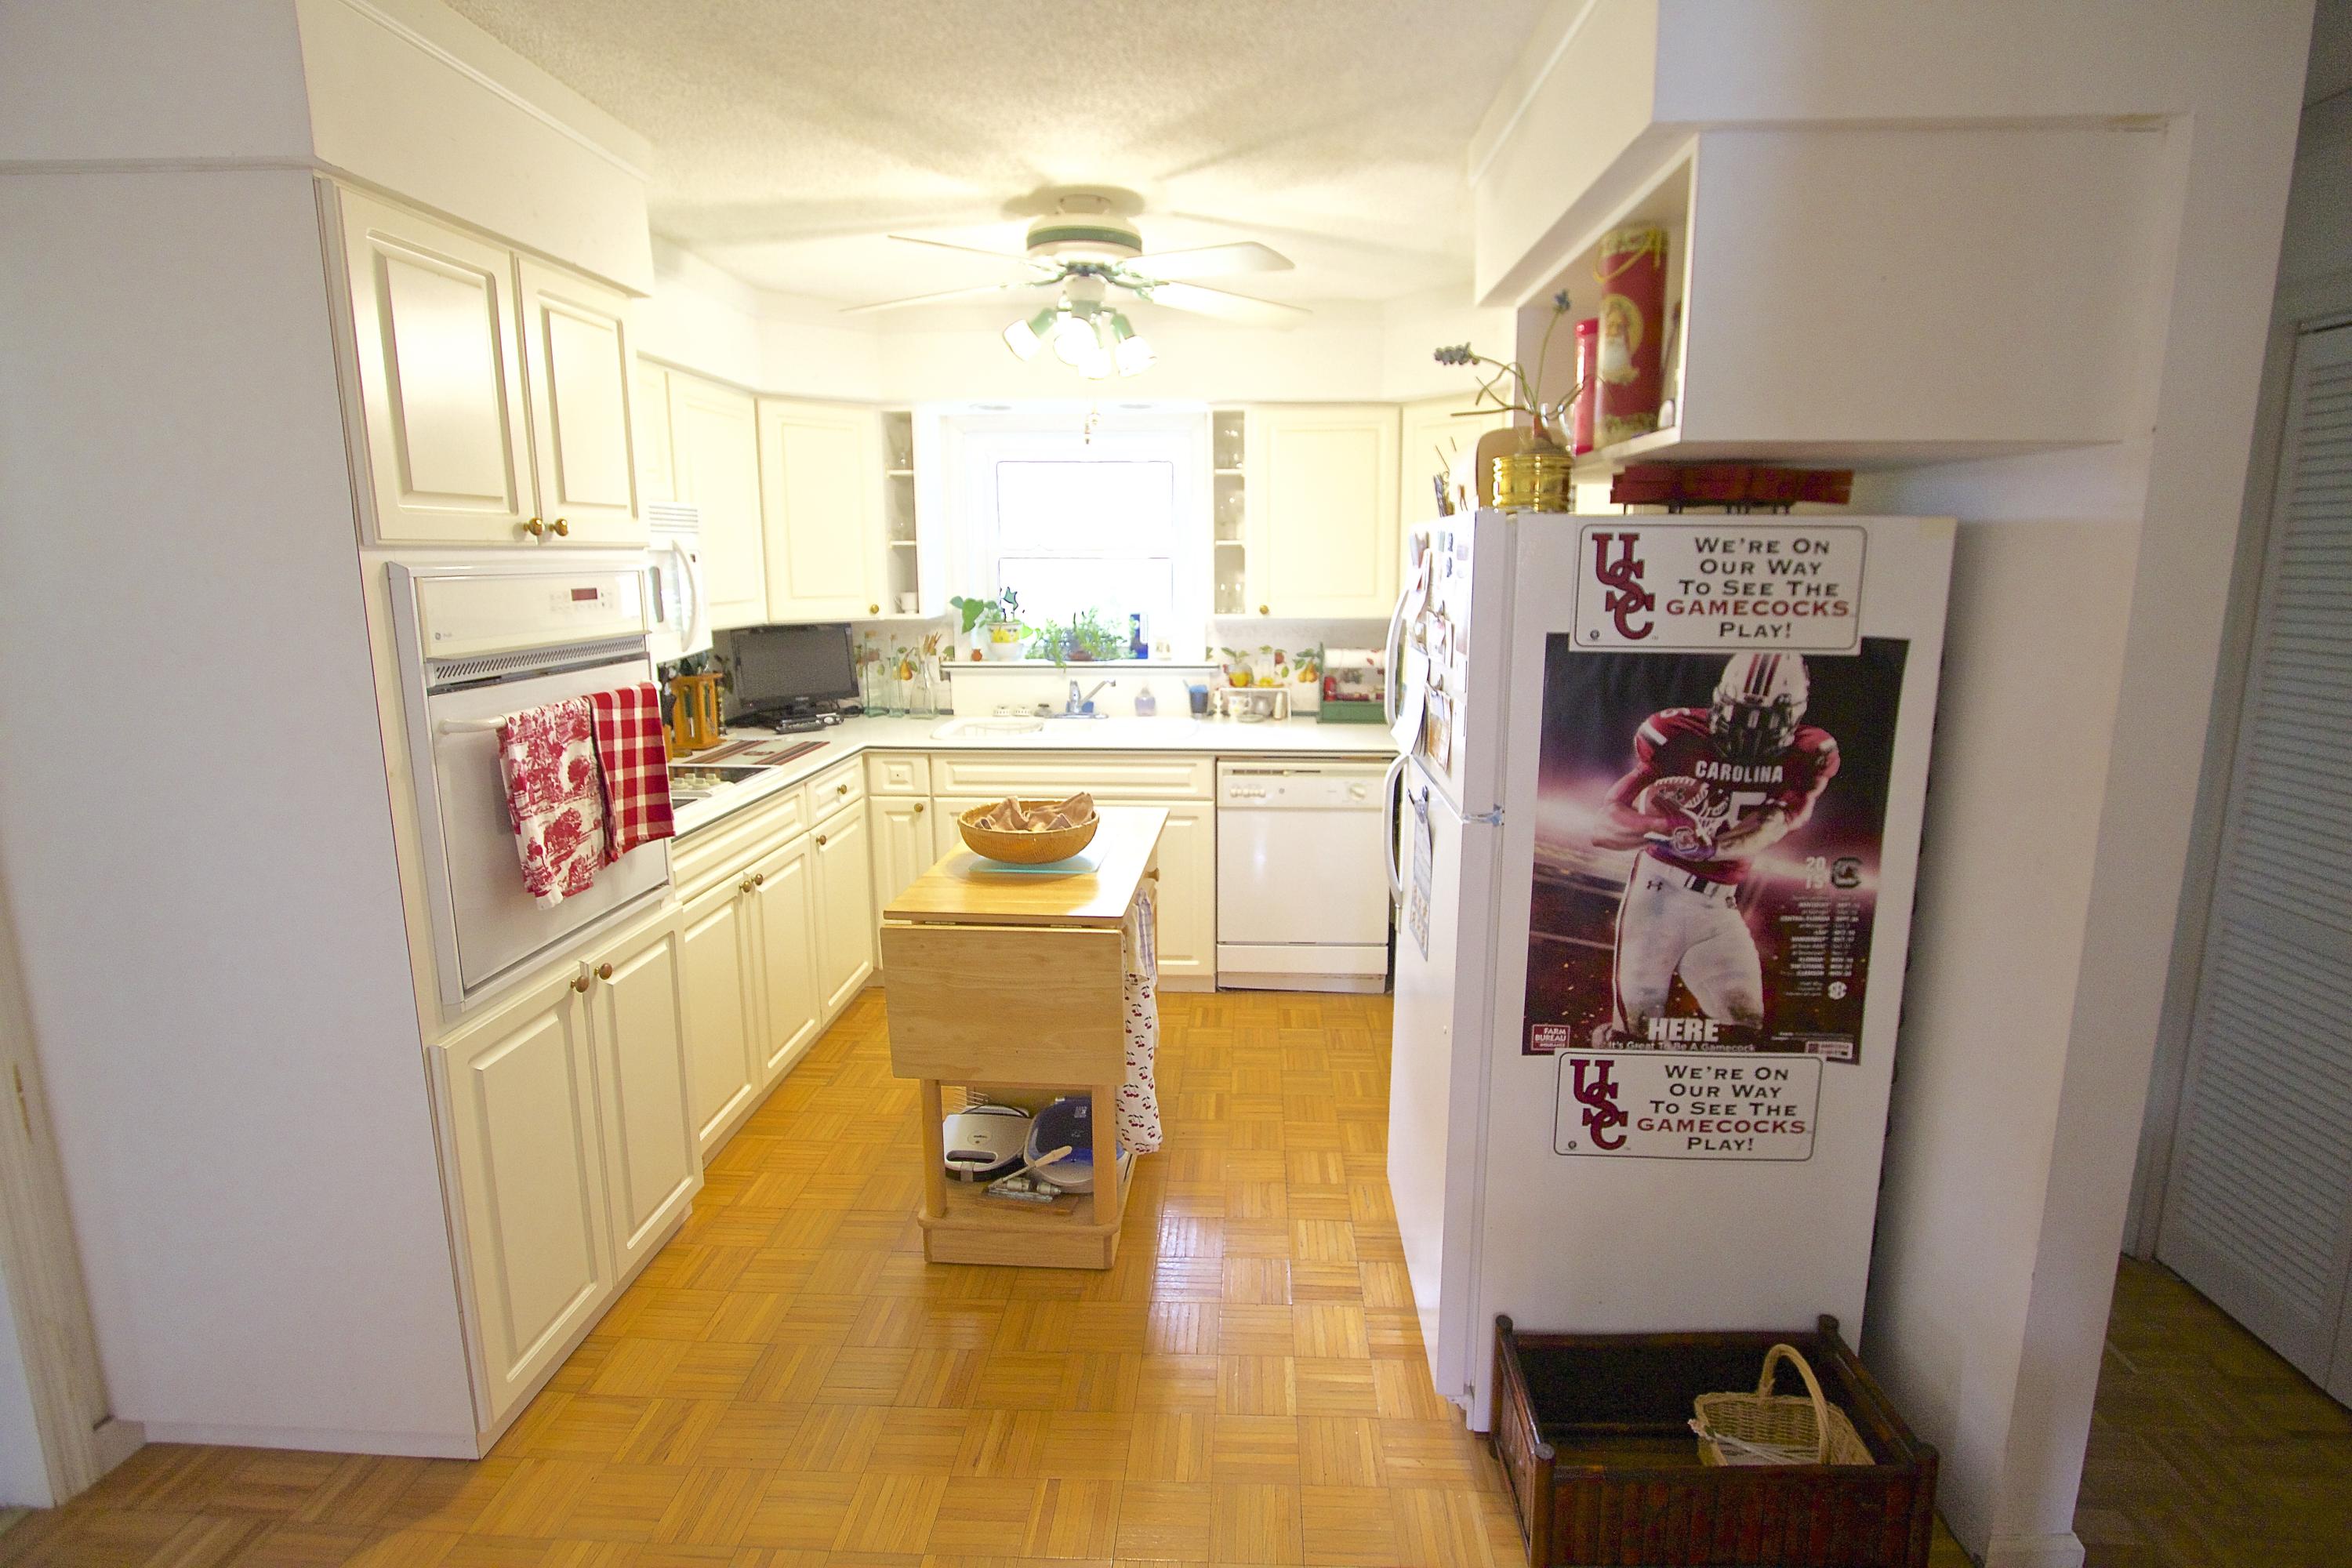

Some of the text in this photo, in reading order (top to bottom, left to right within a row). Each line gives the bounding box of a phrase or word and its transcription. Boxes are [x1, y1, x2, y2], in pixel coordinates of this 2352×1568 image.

[1695, 536, 1830, 554] WE'RE ON
[1700, 559, 1822, 575] OUR WAY
[1679, 579, 1838, 597] TO SEE THE
[1666, 600, 1849, 616] GAMECOCKS
[1720, 622, 1792, 638] PLAY!
[1695, 760, 1783, 783] CAROLINA
[1648, 1017, 1719, 1042] HERE
[1665, 1065, 1788, 1080] WE'RE ON
[1670, 1083, 1781, 1098] OUR WAY
[1650, 1100, 1797, 1116] TO SEE THE
[1637, 1118, 1806, 1134] GAMECOCKS
[1687, 1137, 1754, 1151] PLAY!
